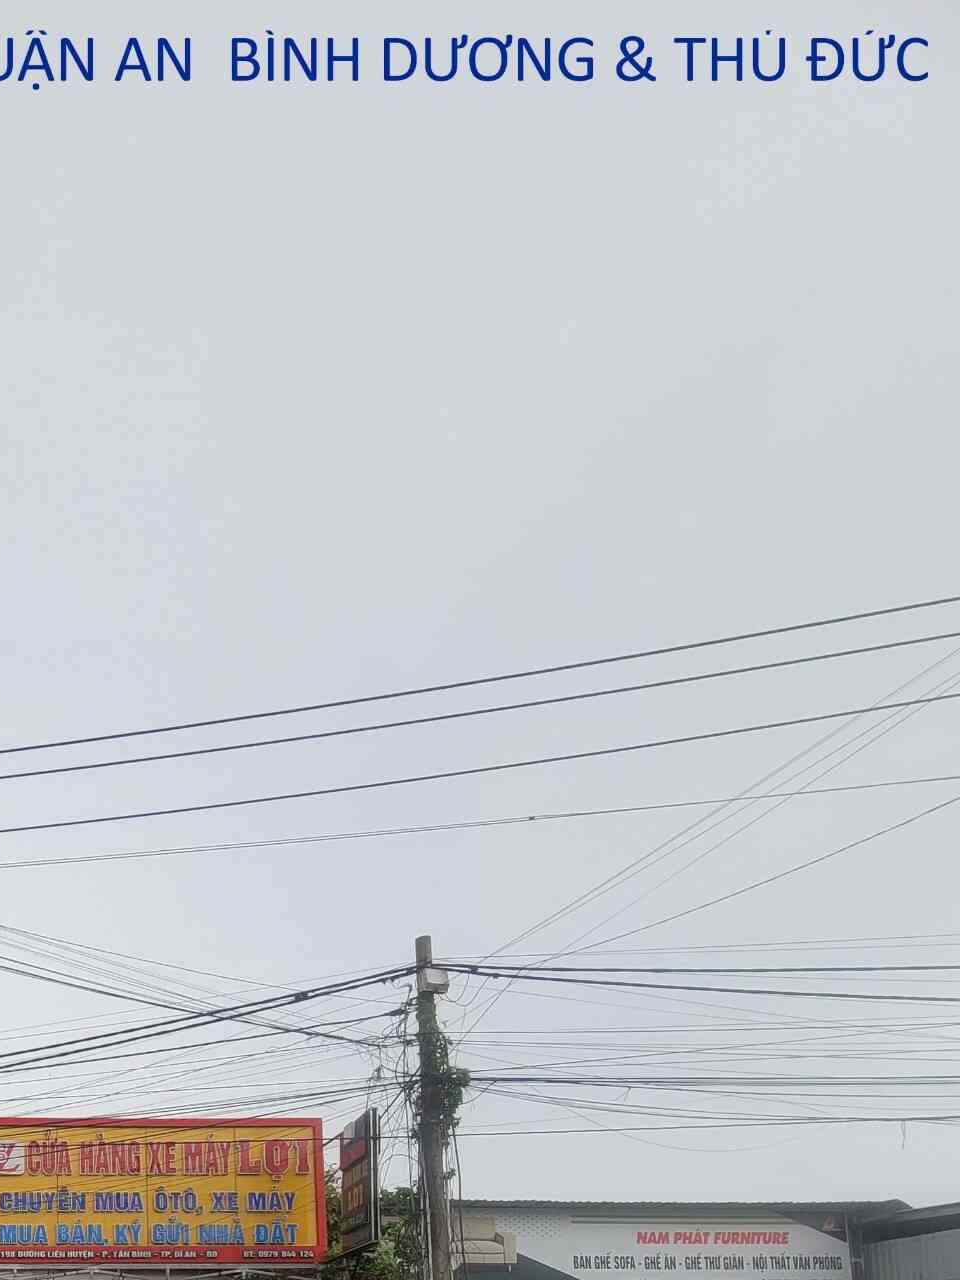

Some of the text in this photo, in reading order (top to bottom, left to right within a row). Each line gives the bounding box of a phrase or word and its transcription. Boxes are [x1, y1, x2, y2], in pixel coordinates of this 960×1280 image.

[26, 1129, 72, 1176] CỬA
[79, 1134, 141, 1176] HÀNG
[148, 1141, 177, 1176] XE
[183, 1133, 231, 1176] MÁY
[237, 1139, 310, 1183] LỢI
[0, 1186, 296, 1215] CHUYÊN MUA ÔTÔ, XE MÁY
[115, 1219, 142, 1245] KÝ
[151, 1216, 191, 1245] GỬI
[197, 1217, 245, 1245] NHÀ
[254, 1215, 298, 1245] ĐẤT
[636, 1227, 790, 1245] NAM PHÁT FURNITURE
[594, 1250, 614, 1270] GHẾ
[614, 1255, 636, 1270] SOFA
[644, 1250, 662, 1270] GHẾ
[685, 1251, 702, 1270] GHẾ
[752, 1252, 768, 1273] NỘI
[769, 1250, 791, 1270] THẤT
[813, 1252, 843, 1270] PHÒNG
